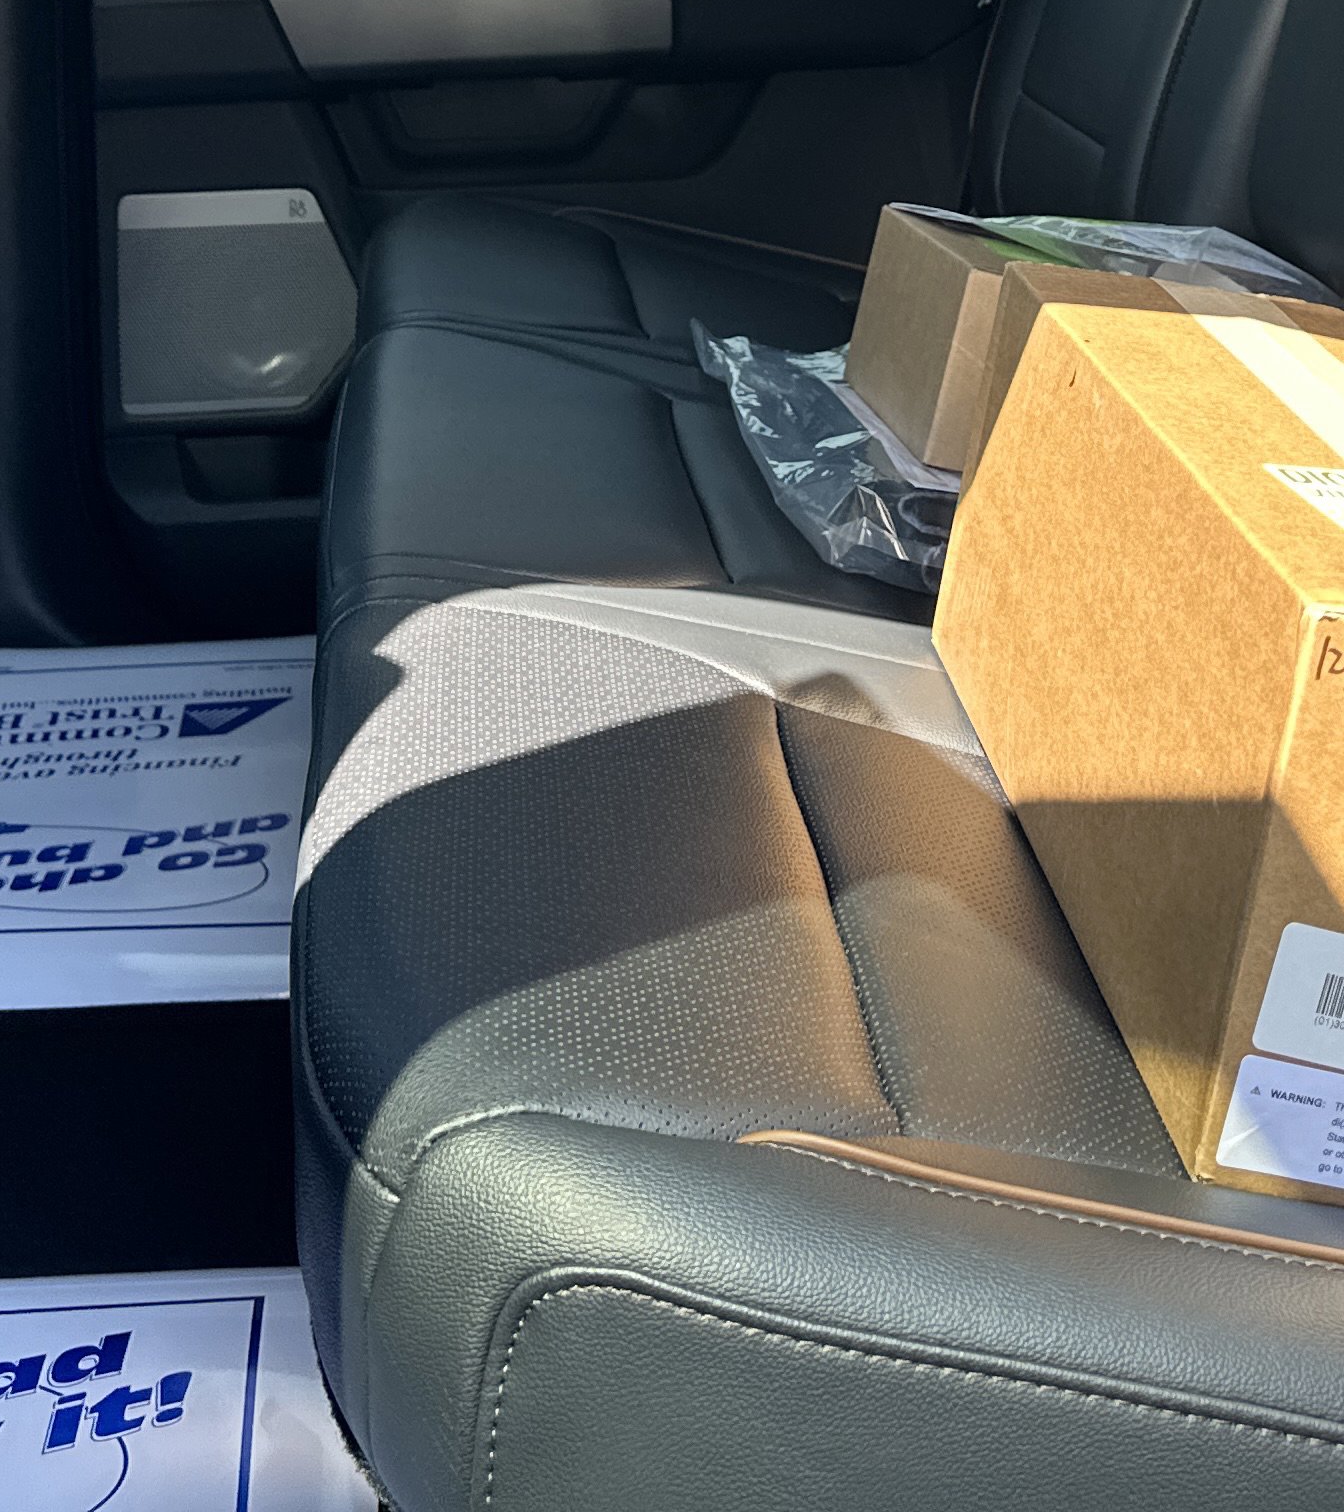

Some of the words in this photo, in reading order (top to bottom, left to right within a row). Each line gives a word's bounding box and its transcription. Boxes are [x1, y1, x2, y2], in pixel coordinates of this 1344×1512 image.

[0, 747, 138, 770] through
[67, 754, 242, 777] Financing
[121, 811, 292, 857] and
[158, 843, 271, 872] Go
[1270, 1088, 1327, 1109] WARNING:
[1322, 1148, 1333, 1157] or
[1318, 1163, 1331, 1174] go
[1333, 1164, 1344, 1175] to
[41, 1371, 193, 1456] it!
